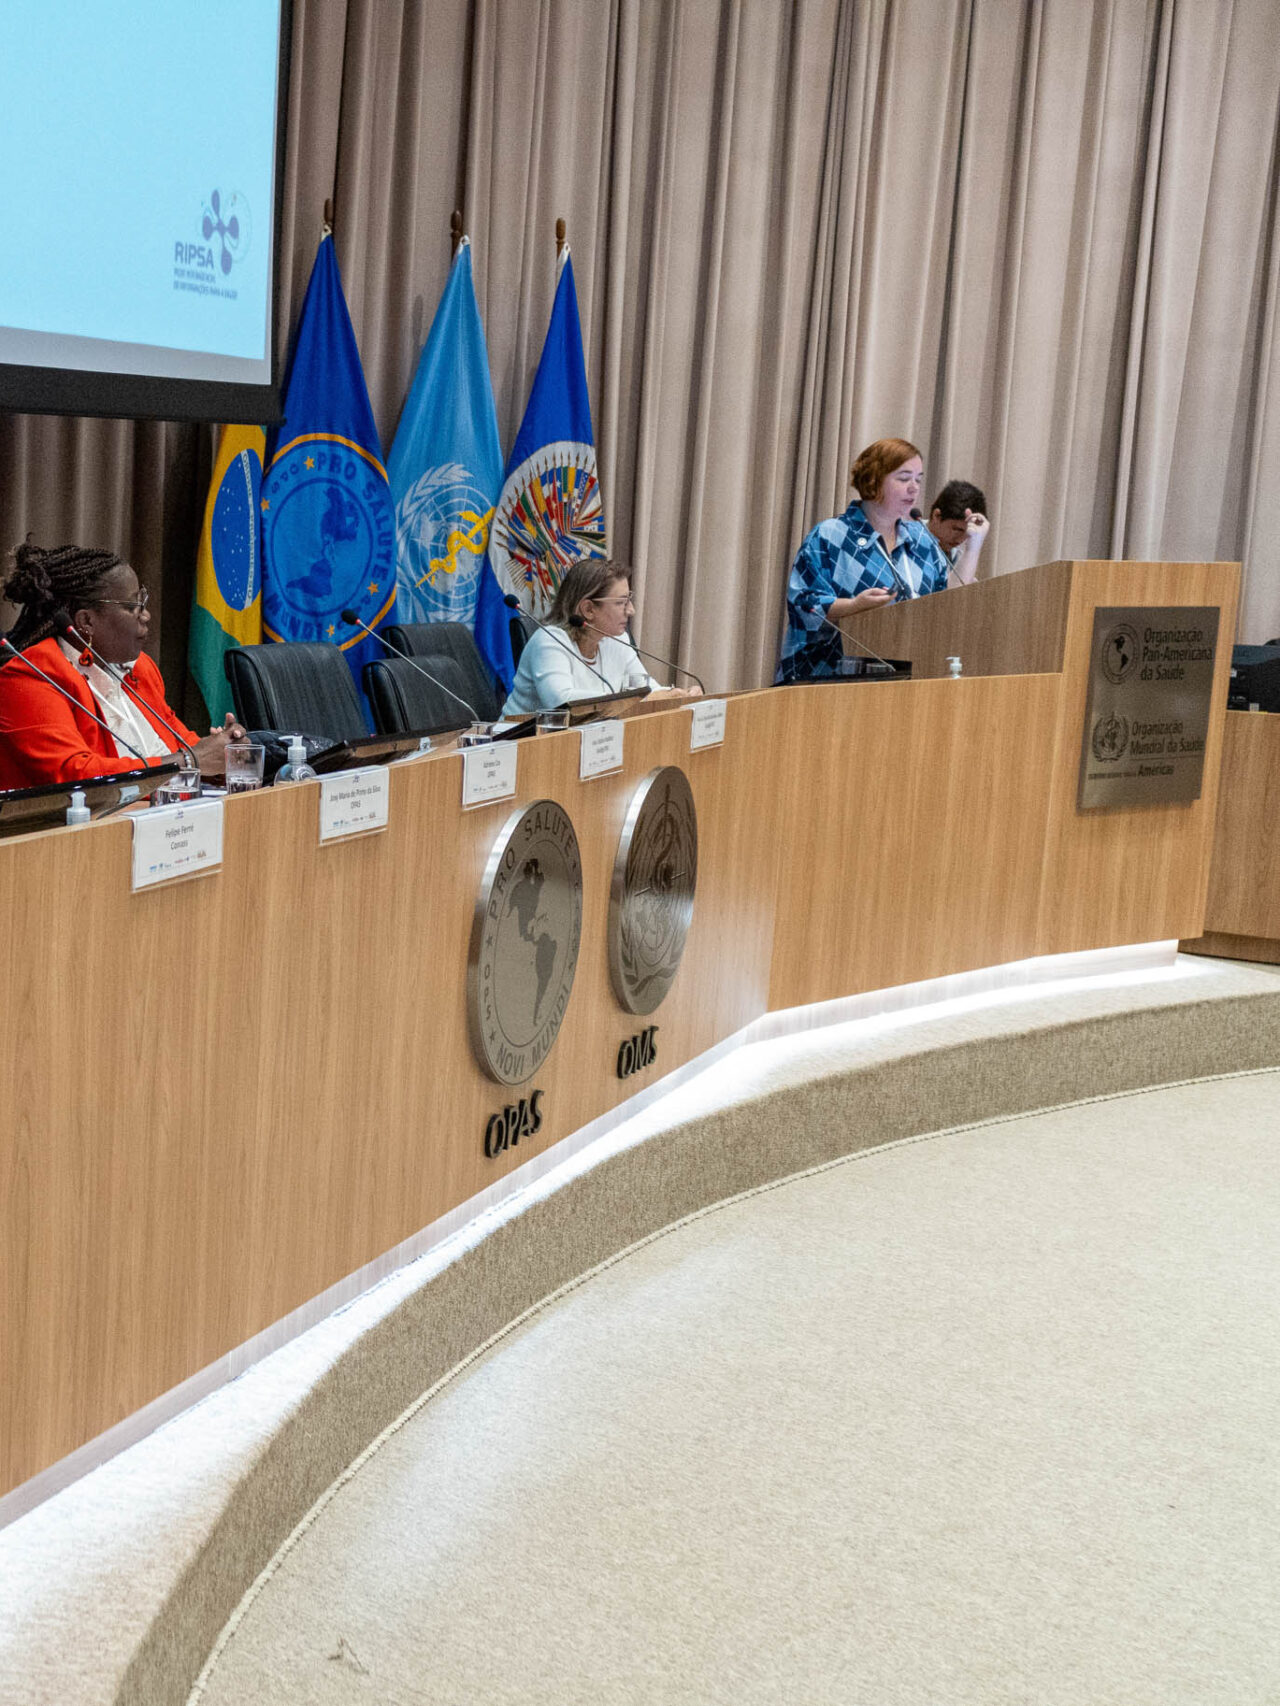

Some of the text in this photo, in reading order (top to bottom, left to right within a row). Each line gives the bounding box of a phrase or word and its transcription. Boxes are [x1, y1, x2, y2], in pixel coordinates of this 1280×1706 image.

[174, 241, 215, 270] RIPSA
[317, 451, 393, 581] PRO SALUTE
[1144, 627, 1203, 647] Organização
[1142, 646, 1213, 662] Pan-Americana
[1140, 665, 1185, 681] da Saúde
[1131, 720, 1184, 739] Organização
[1130, 739, 1165, 755] Mundial
[1167, 740, 1178, 753] da
[165, 827, 181, 838] Felipe
[489, 809, 575, 920] PRO SALUTE
[496, 983, 570, 1078] NOVI MUNDI
[616, 1025, 660, 1079] OMS
[484, 1089, 545, 1159] OPAS
